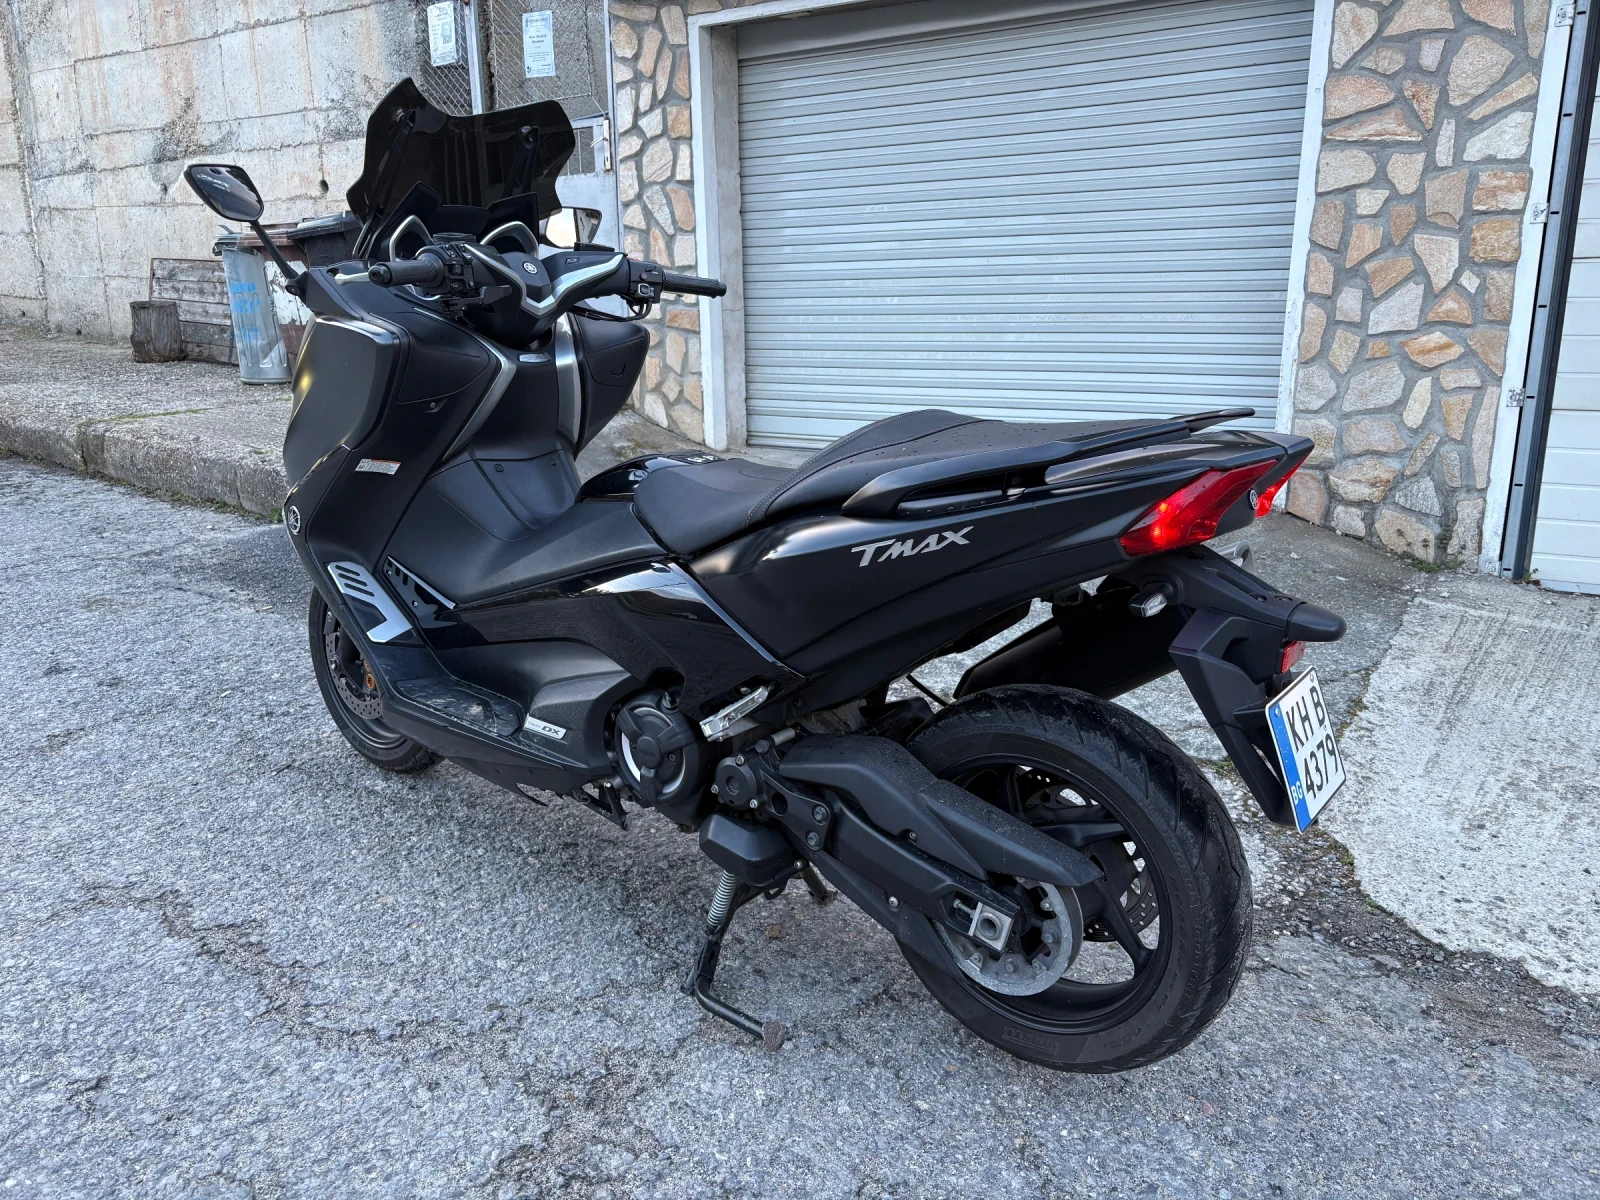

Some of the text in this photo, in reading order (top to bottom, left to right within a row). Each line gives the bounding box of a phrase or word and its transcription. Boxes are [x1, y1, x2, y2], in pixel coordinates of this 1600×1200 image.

[851, 525, 975, 568] TMAX
[541, 725, 561, 736] DX
[1285, 685, 1326, 753] KH B
[1303, 732, 1339, 800] 4379
[1291, 782, 1303, 806] BG
[1002, 1024, 1058, 1056] PIRELLI
